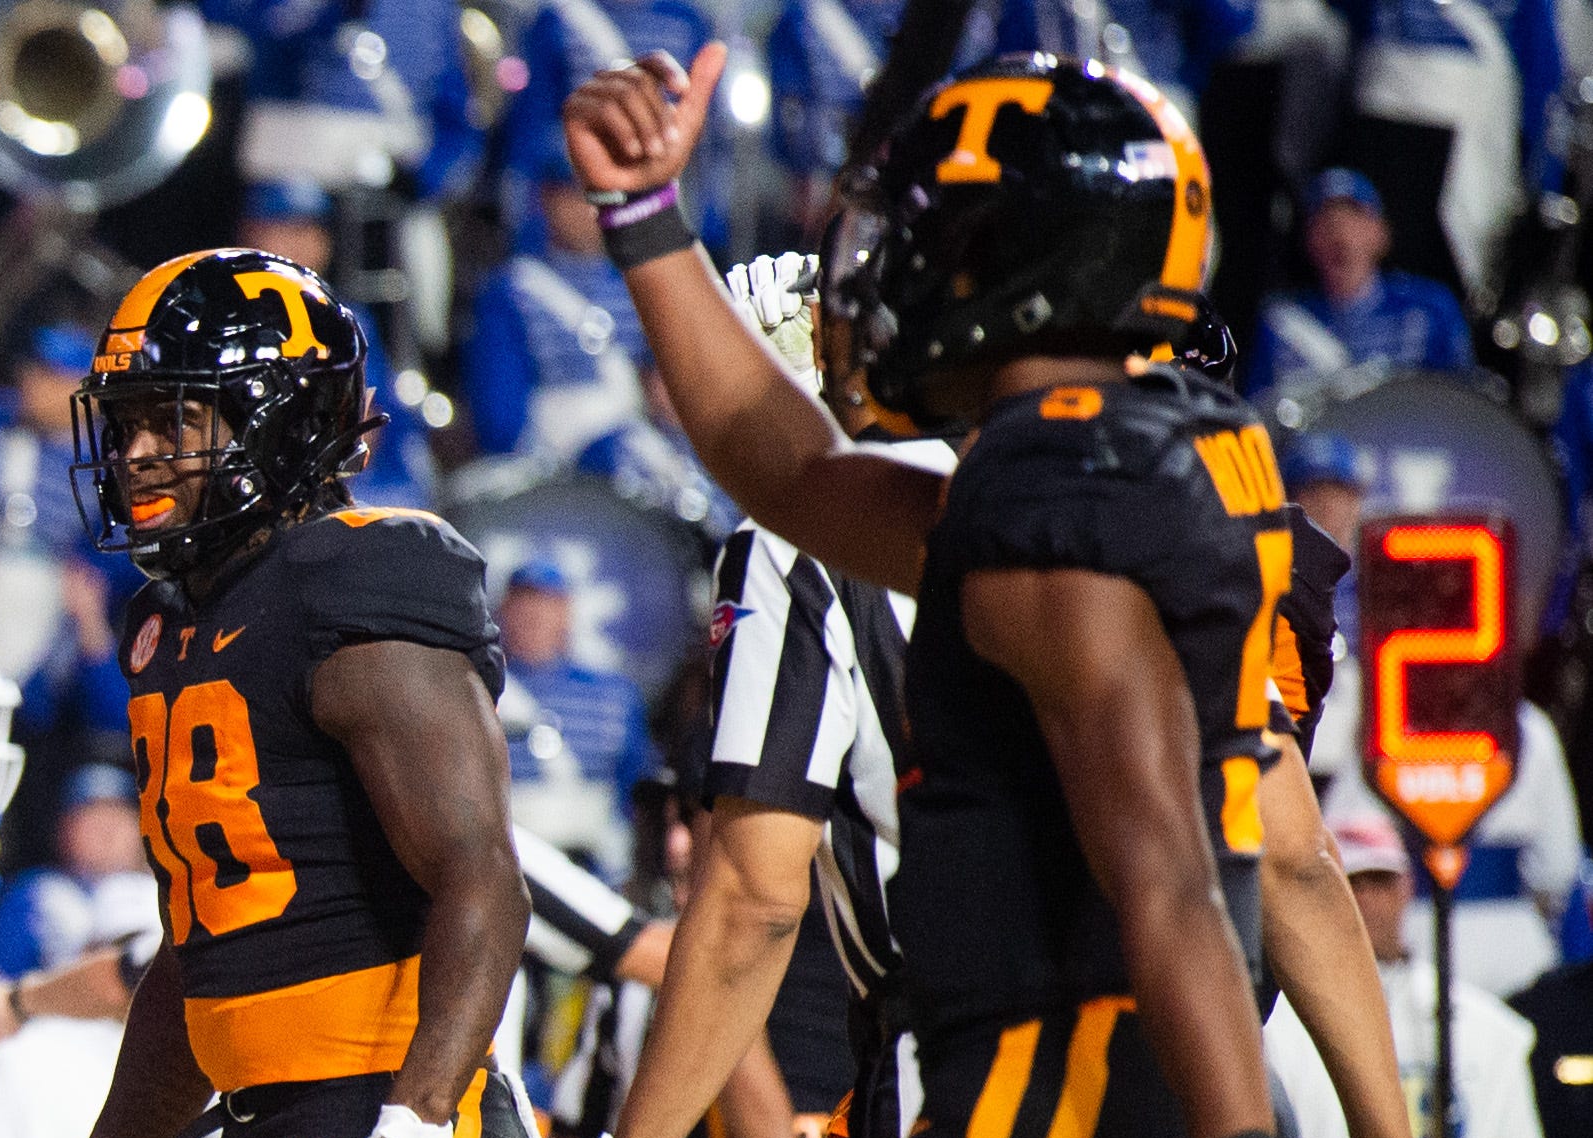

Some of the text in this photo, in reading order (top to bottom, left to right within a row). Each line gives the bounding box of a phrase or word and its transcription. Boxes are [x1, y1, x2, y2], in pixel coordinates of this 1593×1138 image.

[929, 77, 1055, 185] T
[233, 271, 329, 360] T
[1377, 524, 1504, 766] 2
